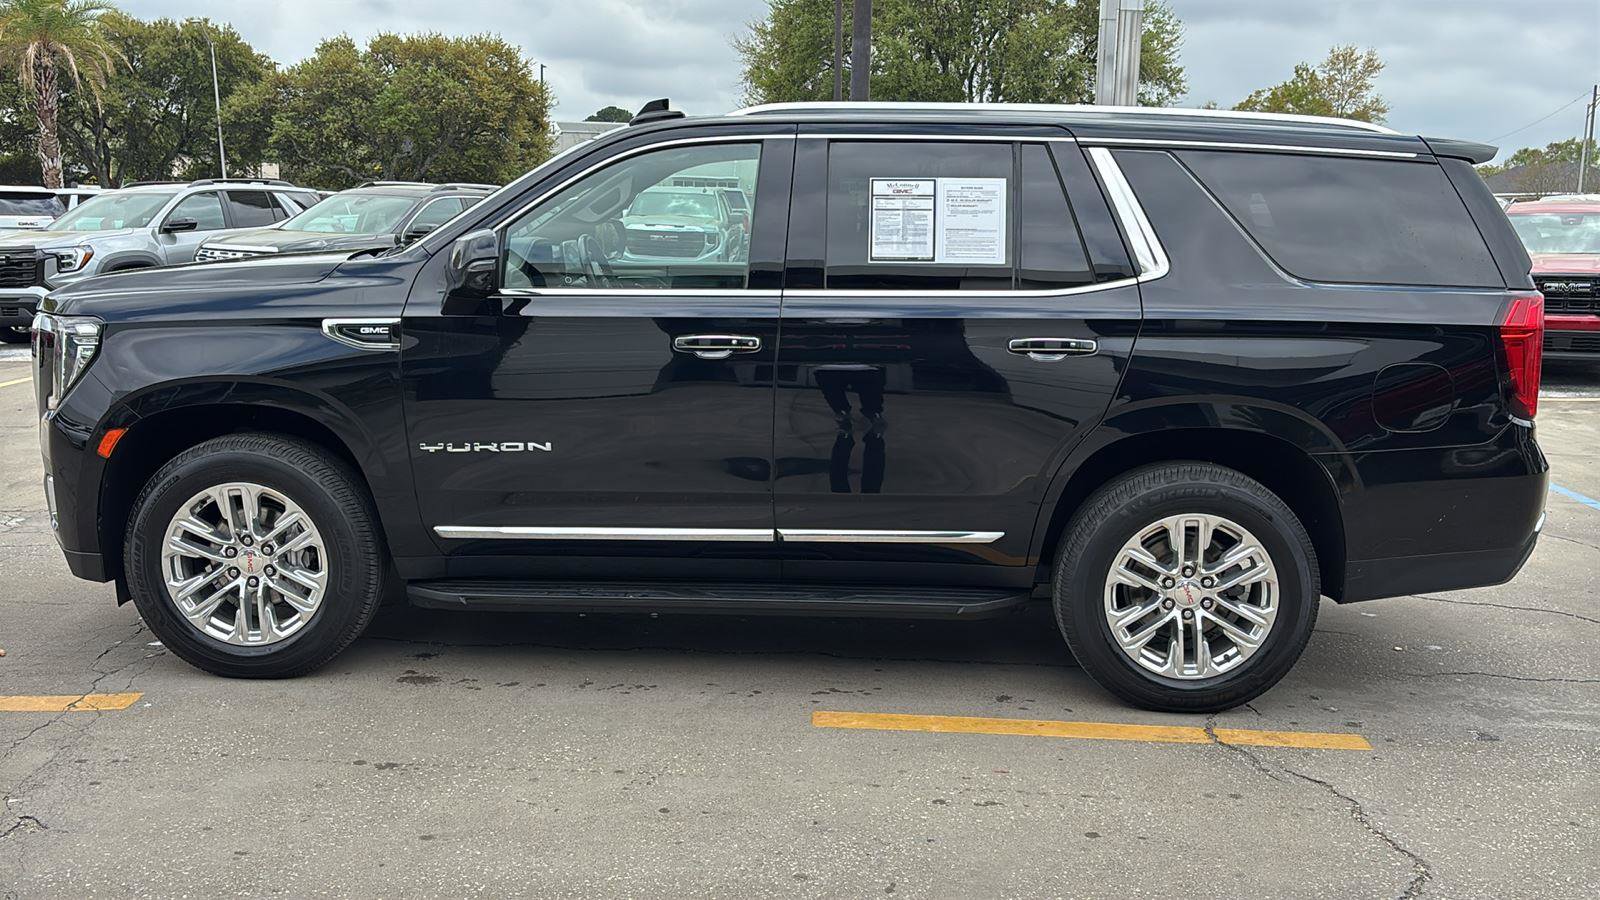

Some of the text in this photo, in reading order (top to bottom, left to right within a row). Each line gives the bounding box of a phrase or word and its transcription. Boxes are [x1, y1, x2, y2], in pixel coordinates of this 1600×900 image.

[1543, 282, 1591, 292] GMC
[359, 326, 390, 334] GMC
[419, 441, 553, 453] YUKON
[246, 551, 254, 573] GMC
[1182, 584, 1194, 606] GMC
